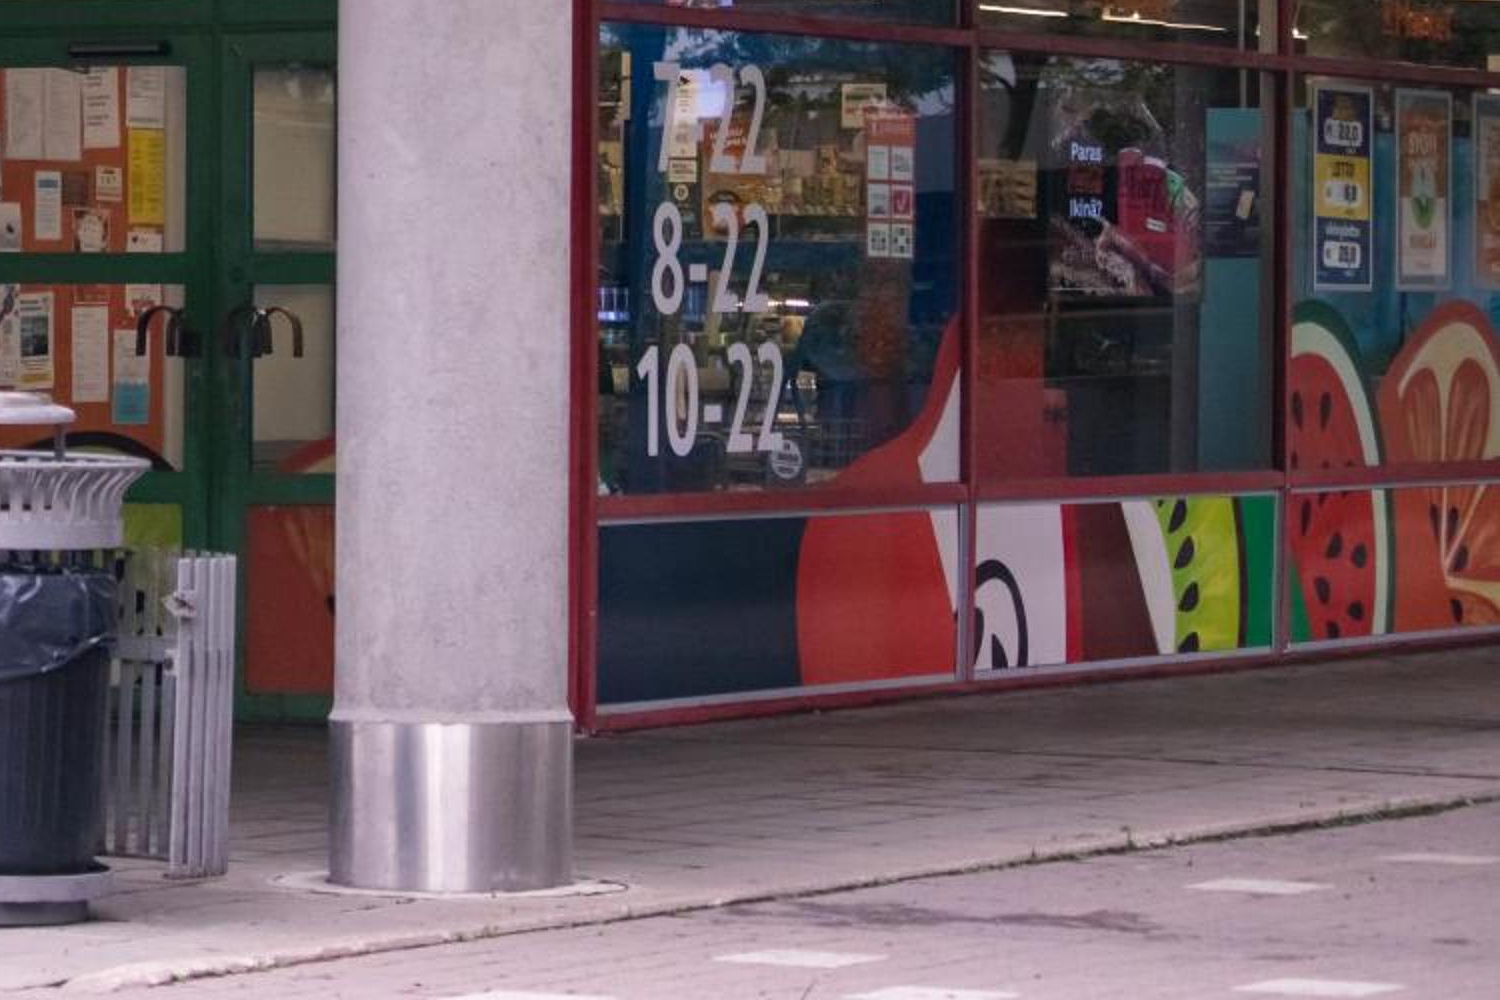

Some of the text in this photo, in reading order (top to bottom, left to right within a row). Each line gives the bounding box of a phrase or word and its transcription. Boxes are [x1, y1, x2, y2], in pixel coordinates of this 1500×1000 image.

[1071, 142, 1102, 162] Paras
[652, 202, 770, 315] 8-22
[637, 341, 784, 458] 10-22
